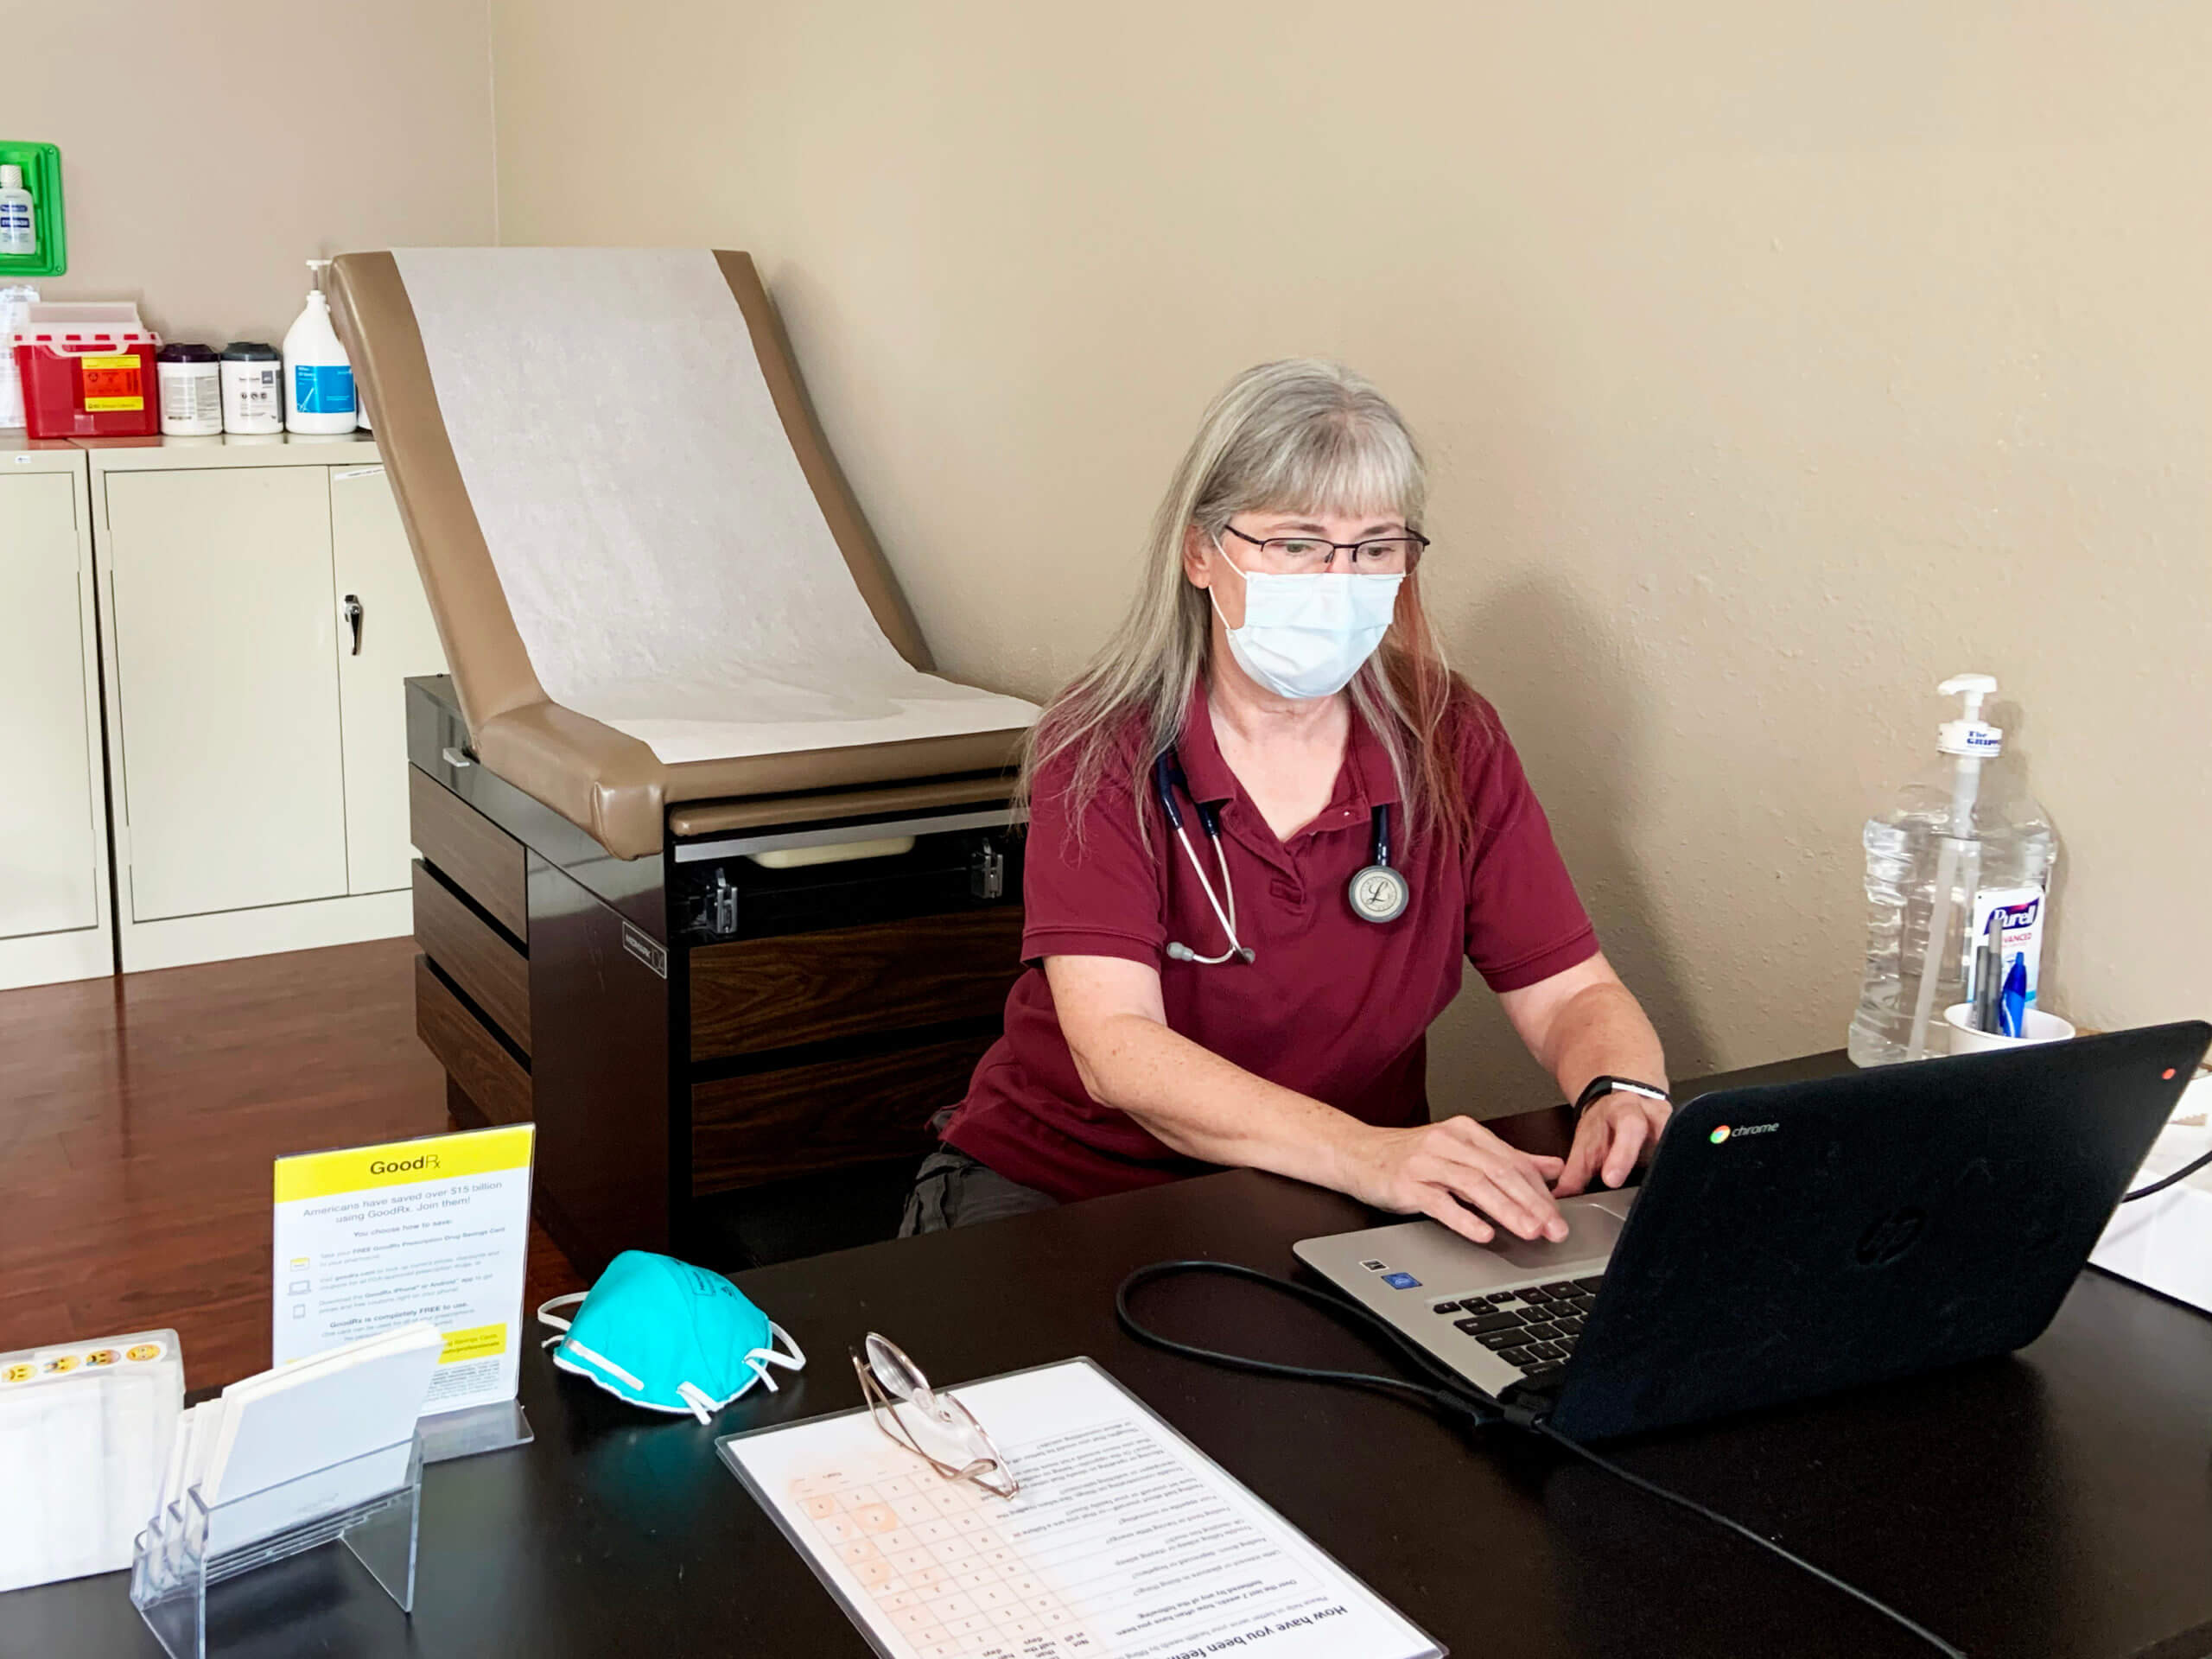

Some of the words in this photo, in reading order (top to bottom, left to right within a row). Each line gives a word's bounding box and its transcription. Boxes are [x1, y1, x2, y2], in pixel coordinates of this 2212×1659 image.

[1732, 1122, 1780, 1138] chrome
[303, 1202, 359, 1217] Americans
[362, 1198, 388, 1208] have
[391, 1192, 422, 1204] saved
[424, 1189, 448, 1198] over
[450, 1185, 469, 1195] $15
[472, 1180, 502, 1192] billion
[335, 1212, 365, 1224] using
[416, 1201, 438, 1211] Join
[442, 1195, 470, 1207] them!
[1311, 1605, 1348, 1621] How
[1274, 1616, 1313, 1631] have
[1244, 1626, 1275, 1641] you
[1205, 1636, 1247, 1653] been
